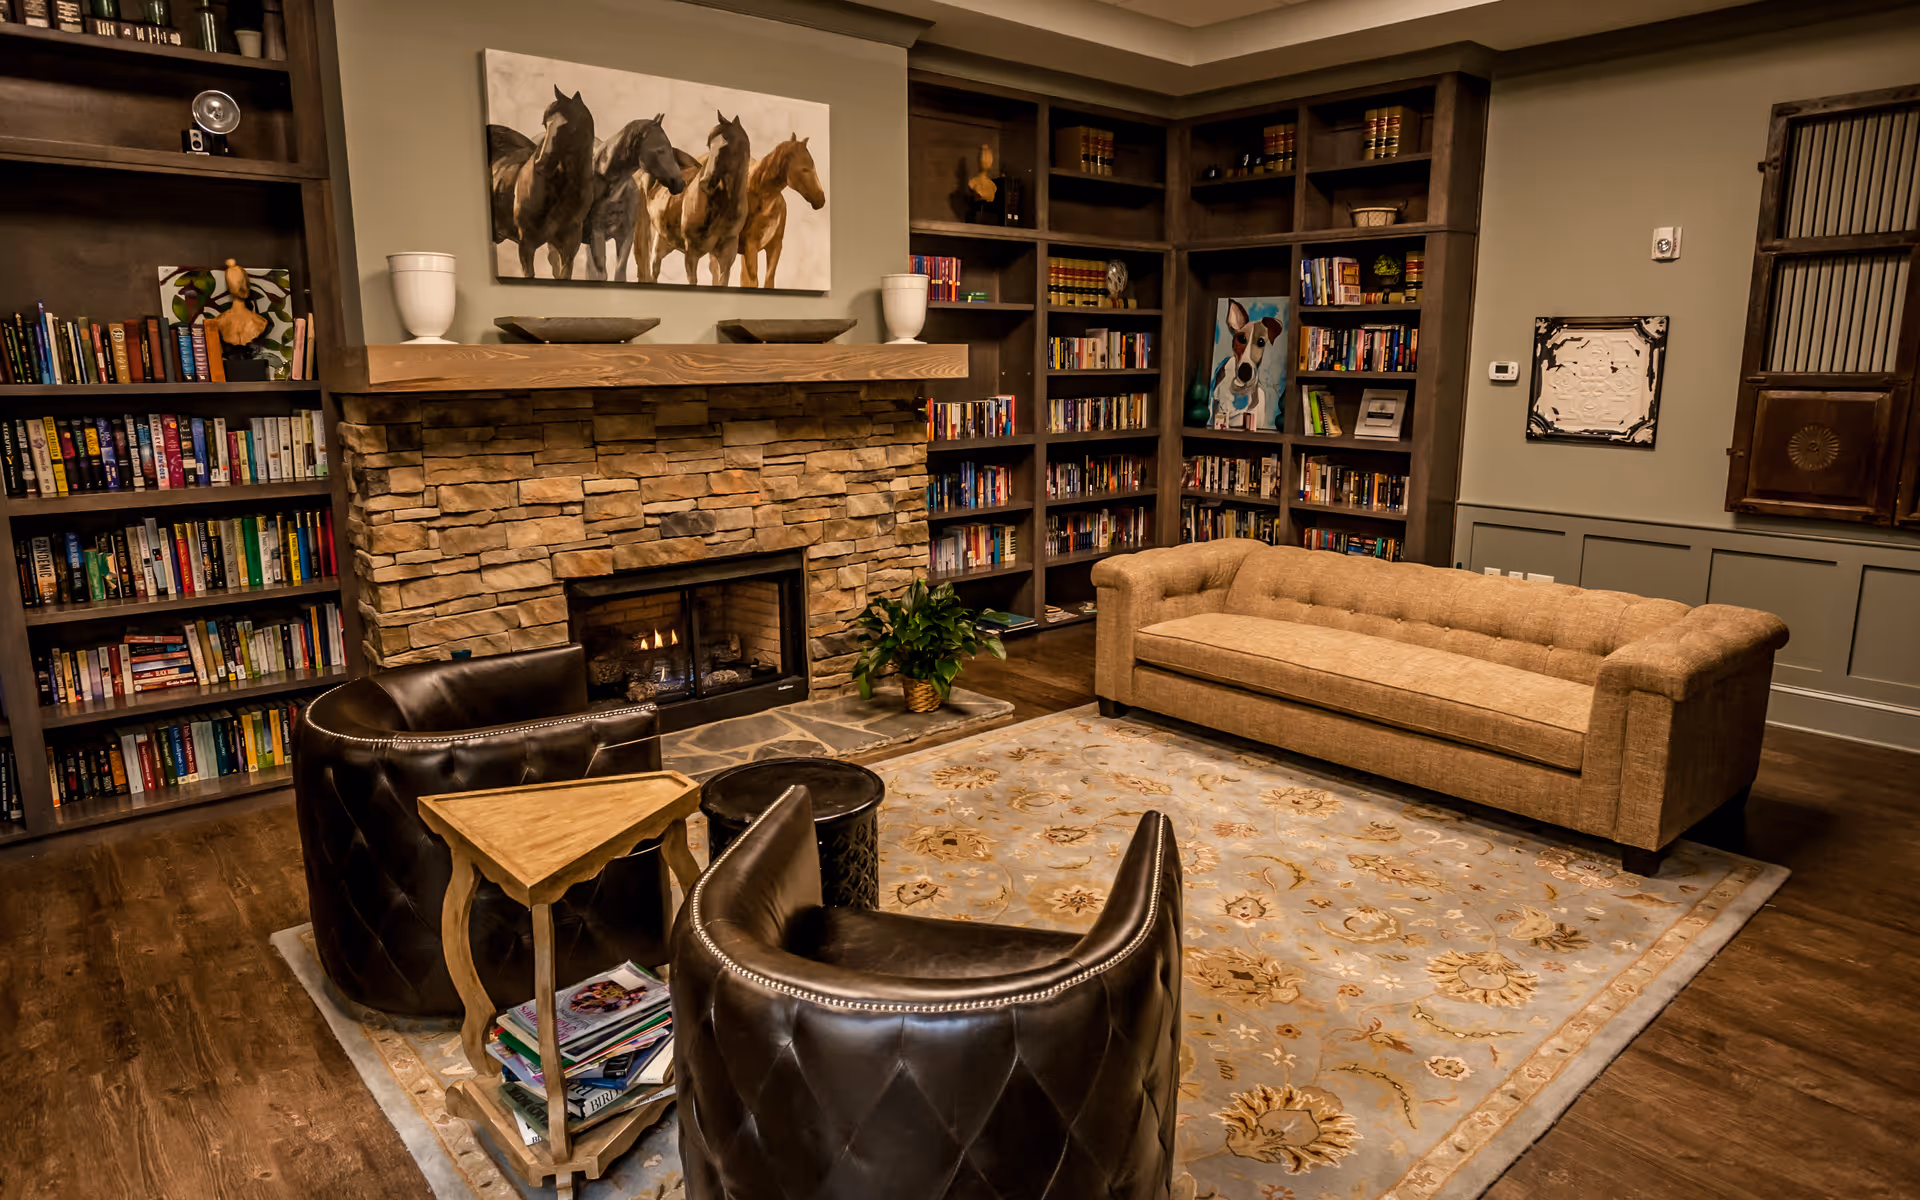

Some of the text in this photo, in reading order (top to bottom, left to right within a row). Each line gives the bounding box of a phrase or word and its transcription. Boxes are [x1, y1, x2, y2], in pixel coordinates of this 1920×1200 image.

[3, 431, 13, 455] GRAFTON
[34, 538, 52, 578] PANDEMIC
[590, 1088, 624, 1112] BIRD
